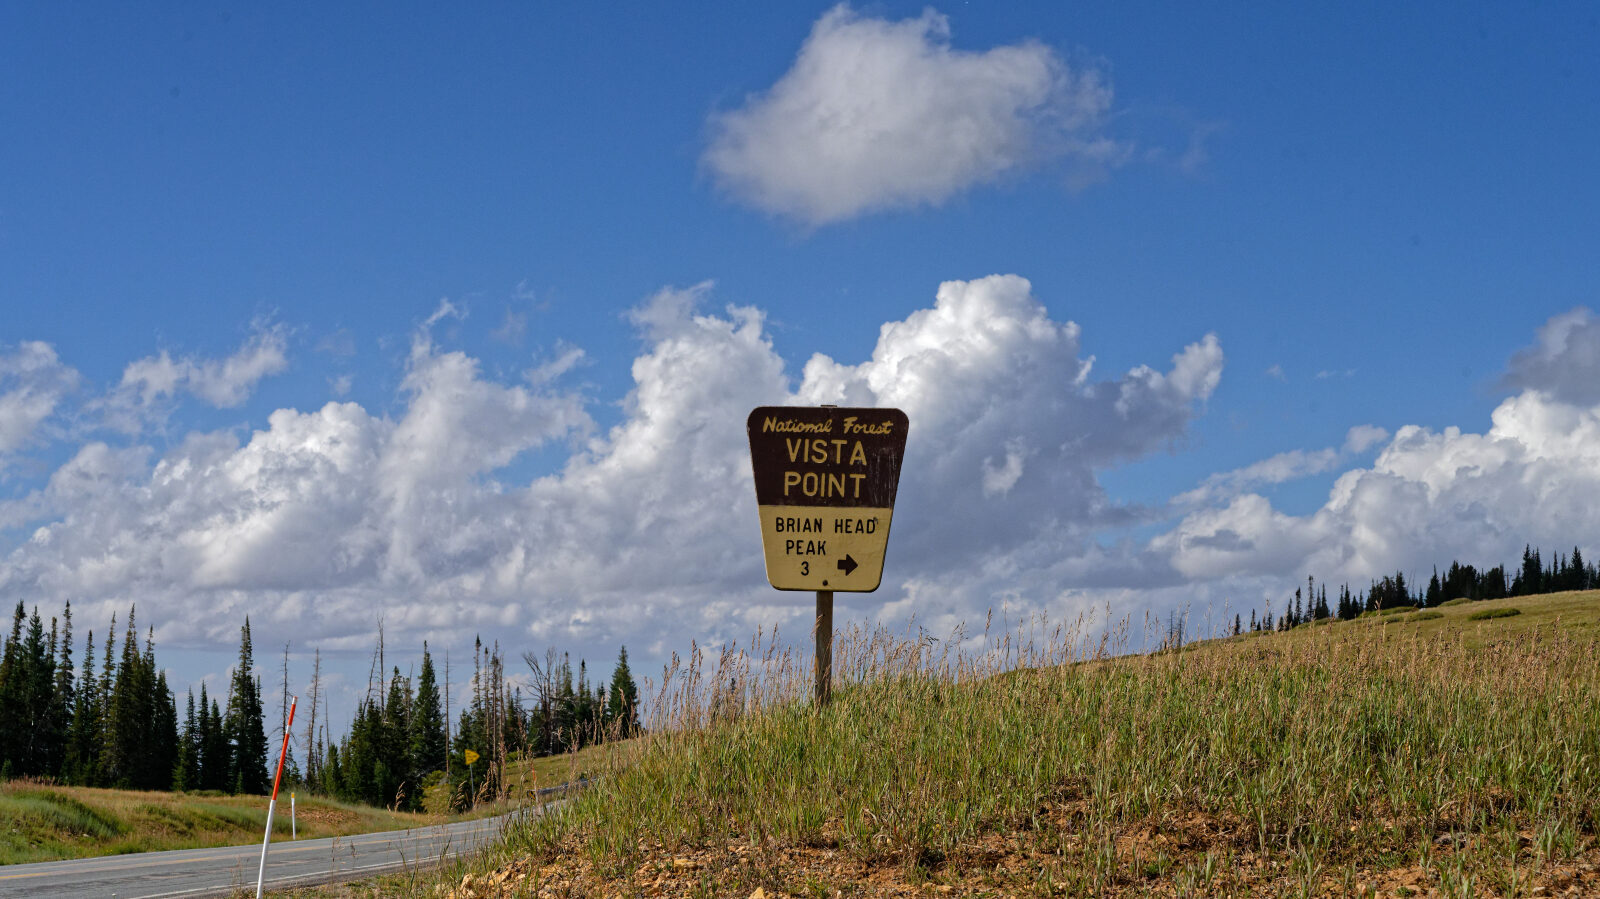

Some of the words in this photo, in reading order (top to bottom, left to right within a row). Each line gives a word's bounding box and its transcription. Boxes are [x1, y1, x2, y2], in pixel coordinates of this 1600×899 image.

[763, 416, 832, 433] National
[844, 416, 893, 434] Forest
[786, 438, 867, 466] VISTA
[784, 471, 866, 498] POINT
[775, 517, 823, 533] BRIAN
[835, 519, 876, 534] HEAD
[786, 540, 827, 556] PEAK
[801, 561, 809, 576] 3
